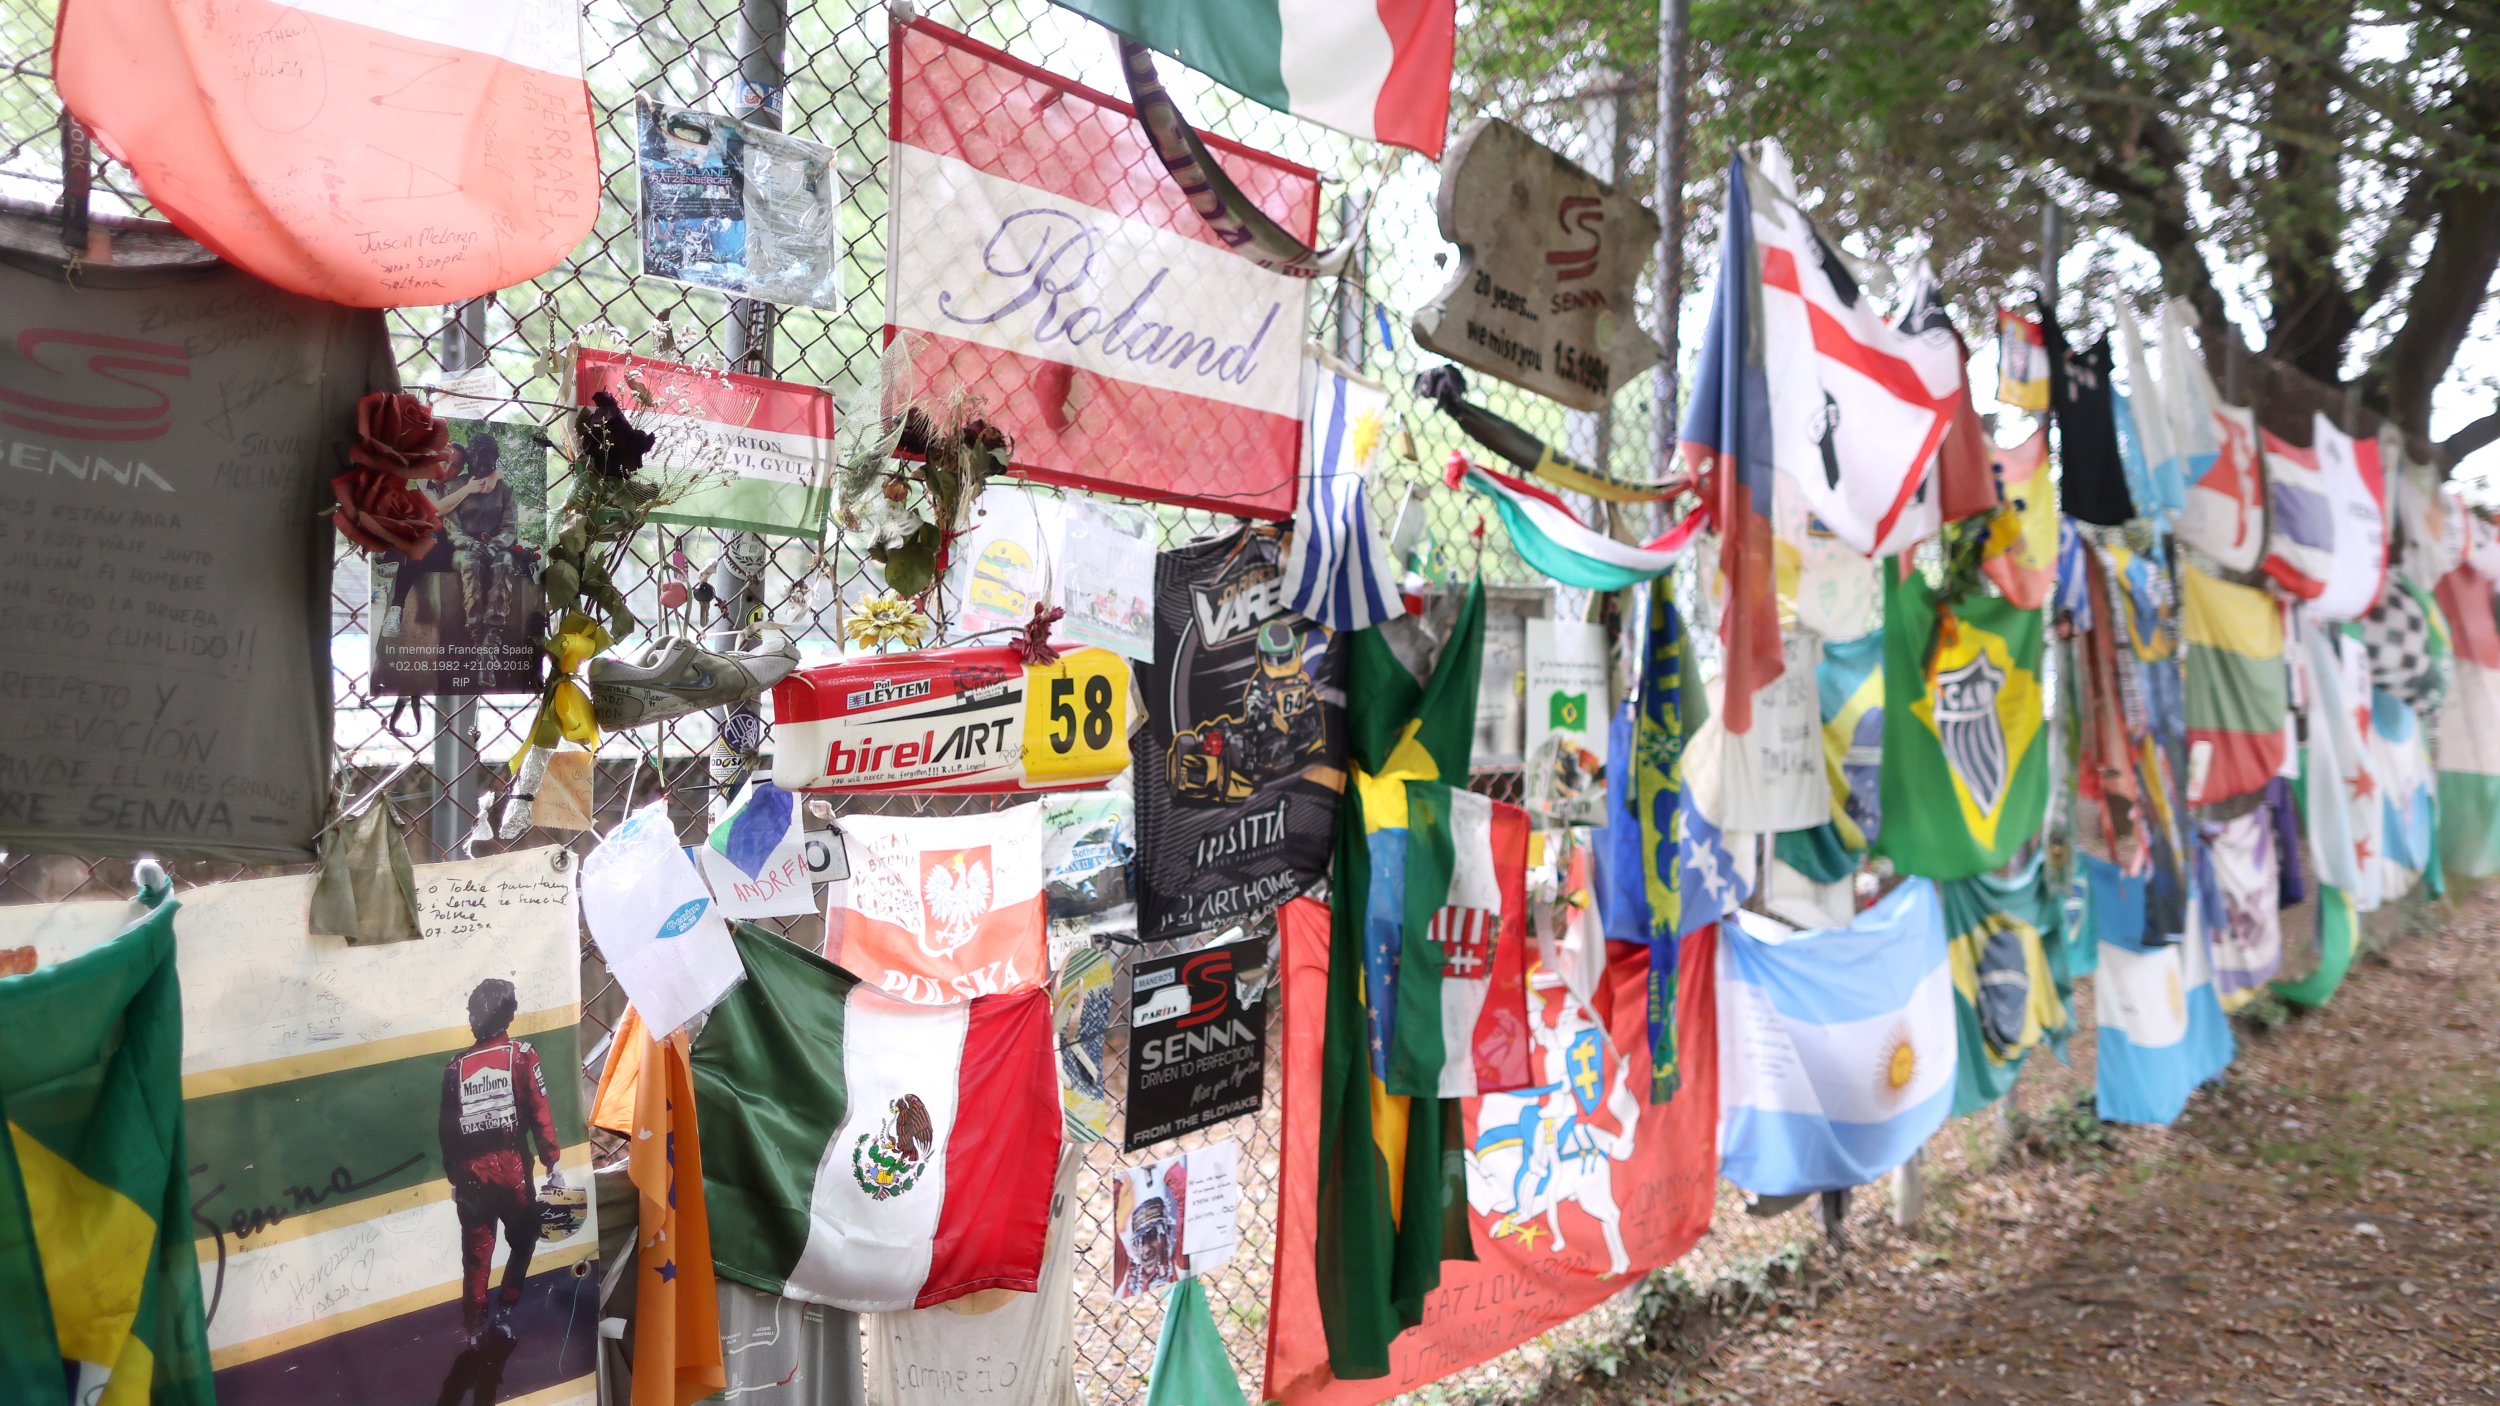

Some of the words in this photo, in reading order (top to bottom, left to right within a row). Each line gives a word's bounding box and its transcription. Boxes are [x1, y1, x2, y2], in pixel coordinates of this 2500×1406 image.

[1474, 269, 1490, 297] 20
[939, 208, 1281, 386] Roland
[1550, 289, 1608, 315] SENNA
[1466, 319, 1487, 345] we
[1516, 344, 1542, 374] you
[714, 434, 782, 454] AYRTON
[760, 457, 817, 477] GYULA
[108, 597, 132, 611] LA
[385, 644, 396, 655] In
[399, 645, 445, 655] memoria
[448, 644, 500, 655] Francesca
[502, 644, 534, 656] Spada
[463, 660, 530, 671] +21.09.2018
[453, 677, 470, 687] RIP
[865, 680, 930, 705] LEYTEM
[875, 681, 890, 690] Pol
[154, 682, 180, 720] Y
[1283, 692, 1304, 715] 64
[1048, 674, 1114, 755] 58
[831, 778, 844, 786] you
[848, 775, 860, 783] will
[863, 773, 884, 782] never
[78, 790, 234, 836] SENNA
[1243, 869, 1296, 907] HOME
[880, 955, 1022, 1006] POLSKA
[1140, 1019, 1256, 1071] SENNA
[1141, 1068, 1179, 1089] DRIVEN
[1181, 1062, 1194, 1077] TO
[1196, 1045, 1254, 1072] PERFECTION
[463, 1072, 509, 1098] Marlboro
[1133, 1121, 1172, 1144] FROM
[1175, 1112, 1199, 1131] THE
